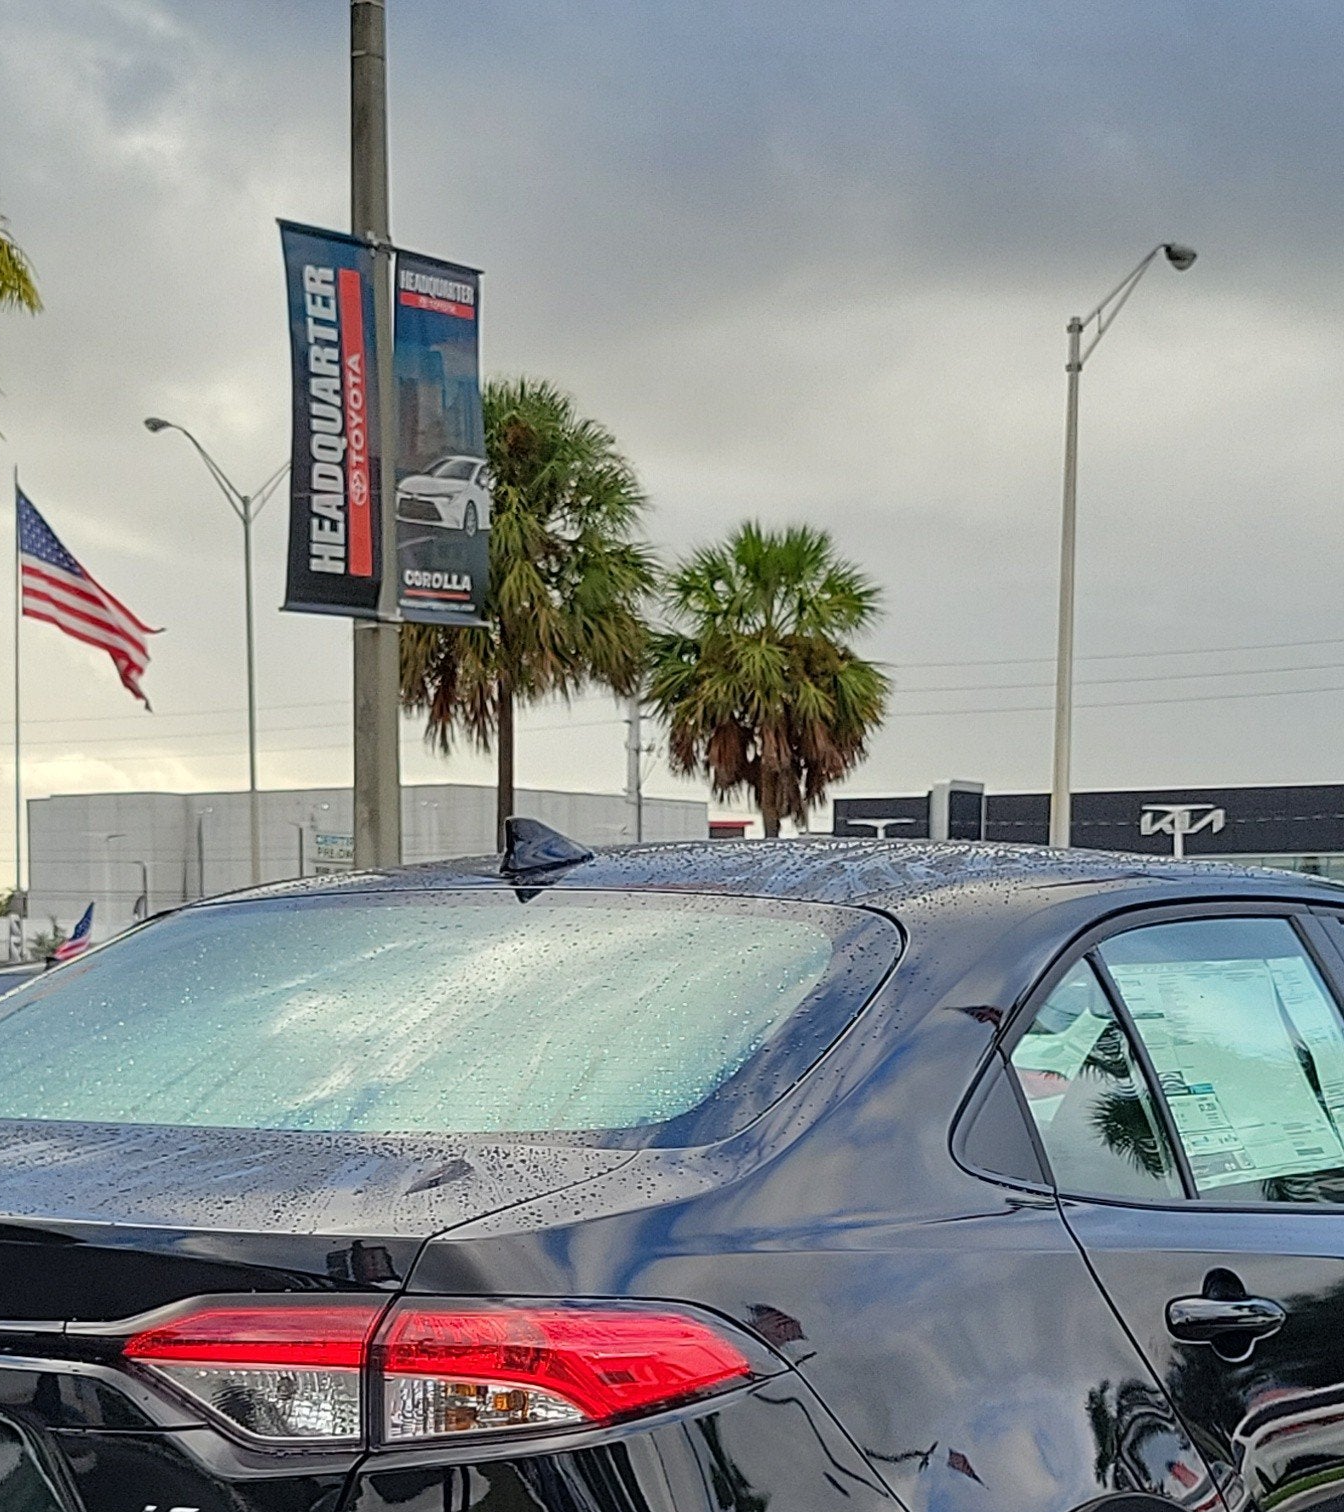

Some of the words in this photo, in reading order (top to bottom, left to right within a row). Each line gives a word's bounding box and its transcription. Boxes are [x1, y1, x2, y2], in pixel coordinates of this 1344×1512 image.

[400, 270, 475, 305] HEADQUARTER
[303, 264, 347, 575] HEADQUARTER
[346, 353, 365, 467] TOYOTA
[404, 569, 472, 592] COROLLA
[1140, 808, 1226, 835] KIA
